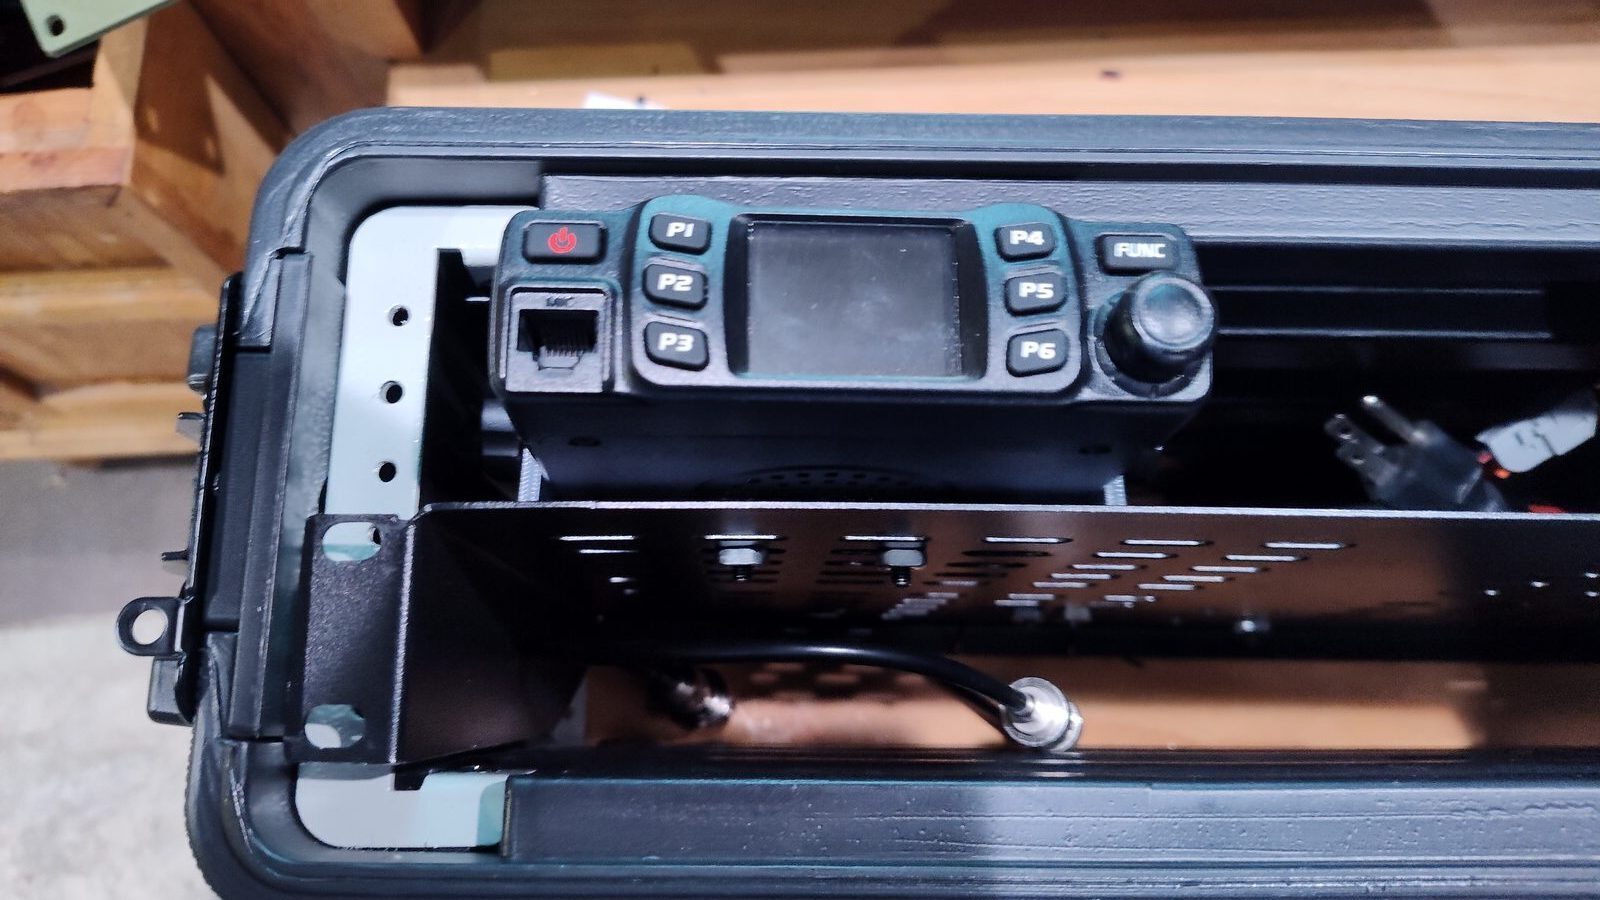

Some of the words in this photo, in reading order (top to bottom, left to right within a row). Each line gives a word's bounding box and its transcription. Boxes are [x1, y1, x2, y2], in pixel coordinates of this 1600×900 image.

[665, 222, 695, 237] P1
[1009, 230, 1045, 245] P4
[1113, 242, 1167, 259] FUNC
[657, 273, 693, 291] P2
[1018, 282, 1054, 299] P5
[658, 332, 694, 351] P3
[1020, 341, 1056, 360] P6
